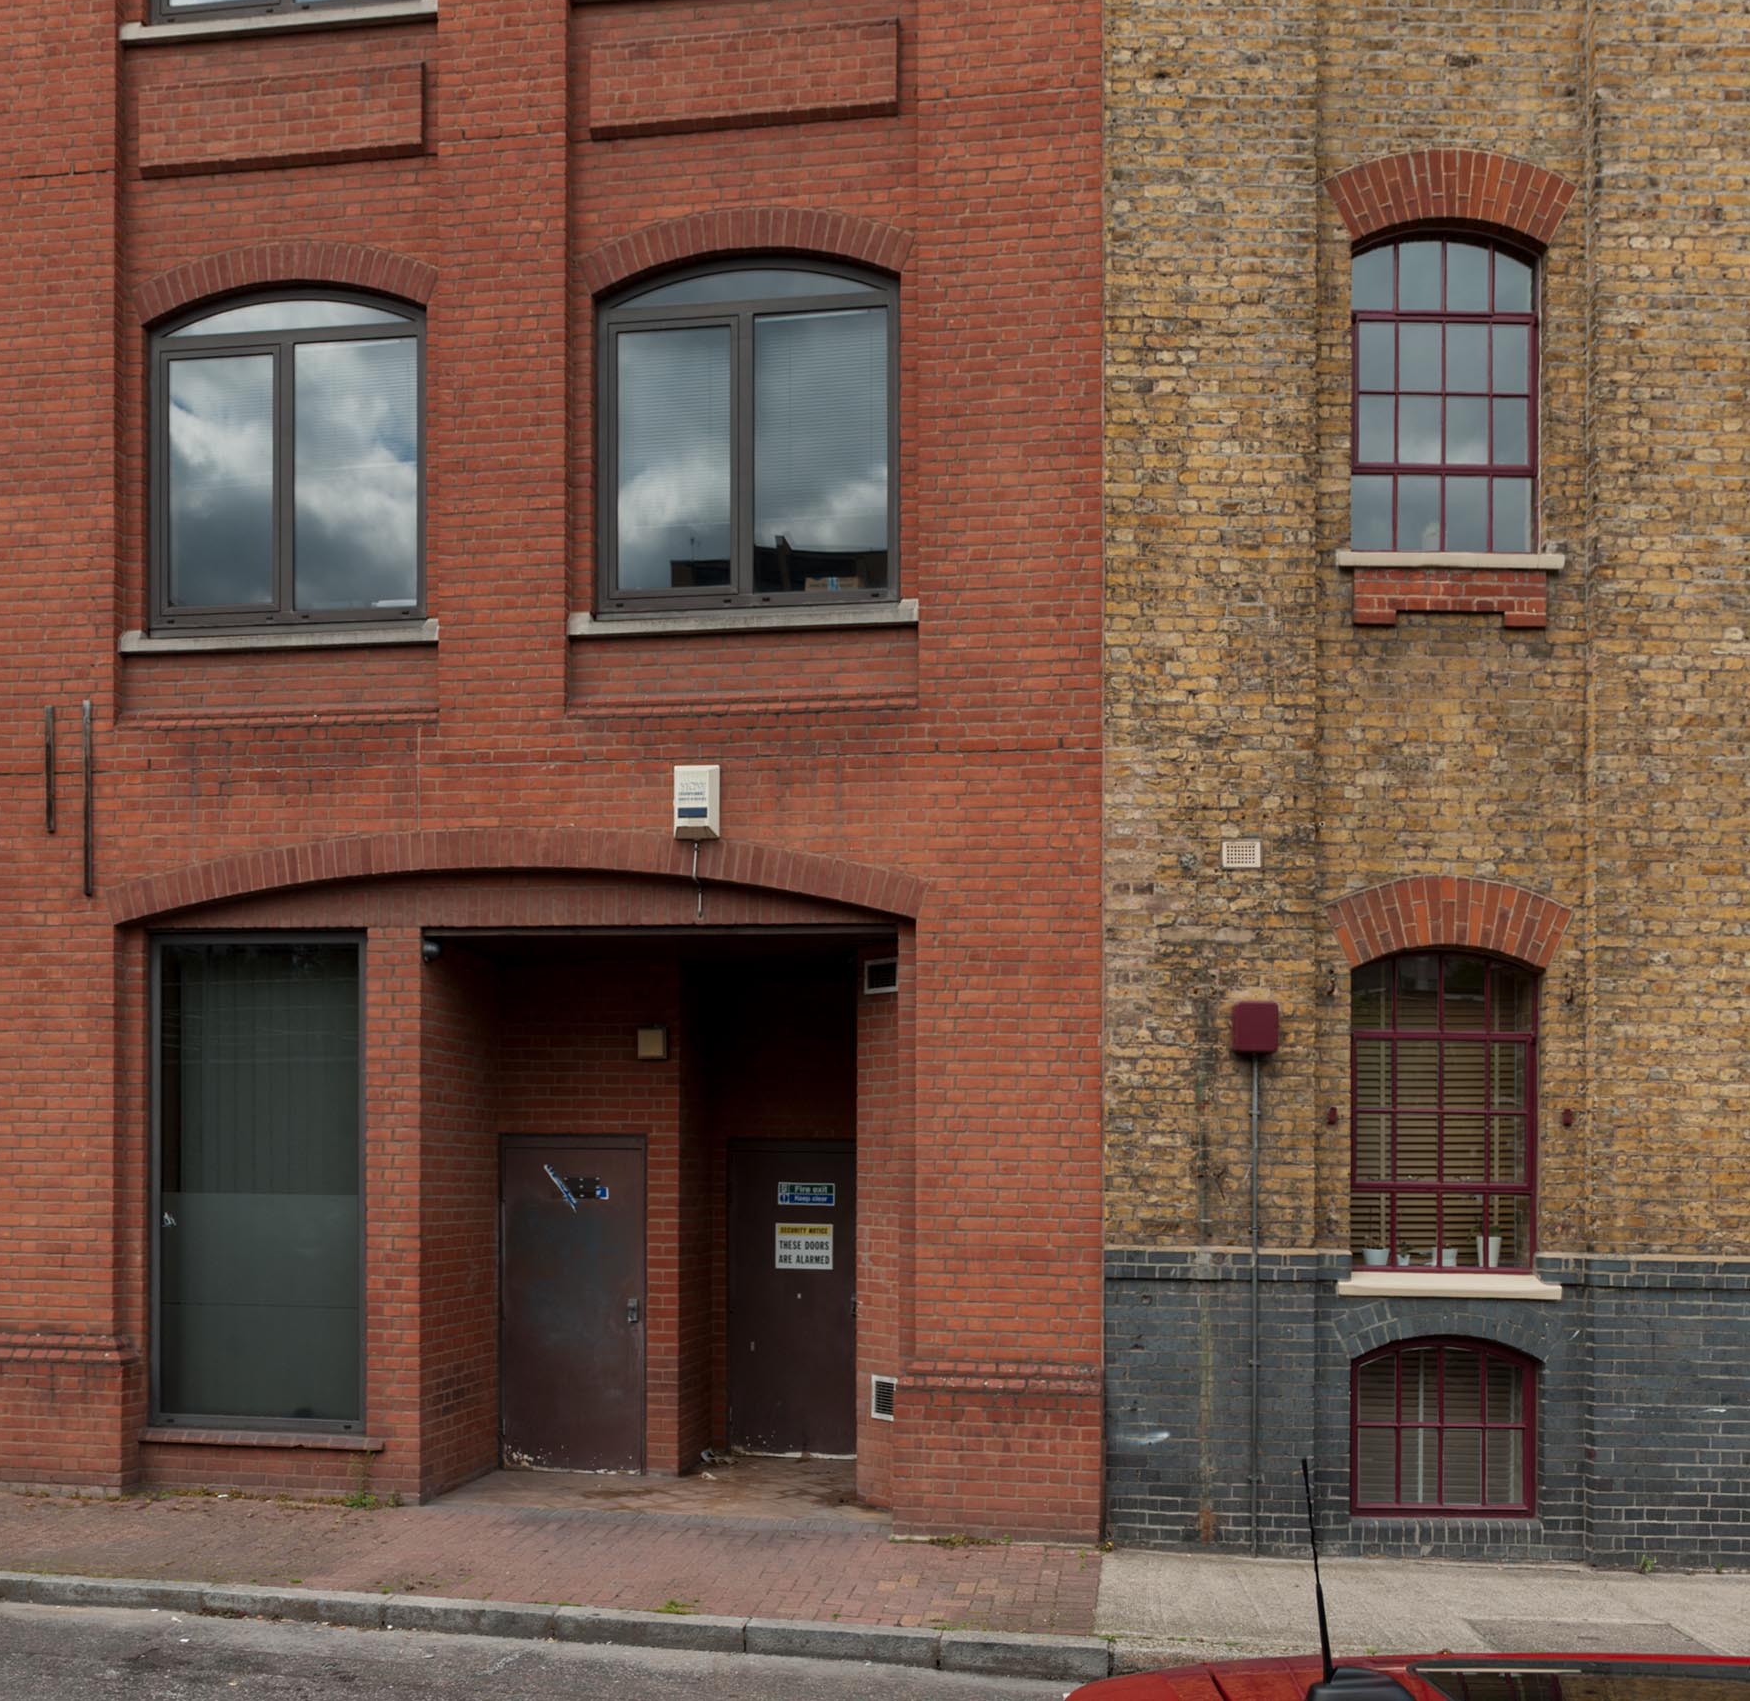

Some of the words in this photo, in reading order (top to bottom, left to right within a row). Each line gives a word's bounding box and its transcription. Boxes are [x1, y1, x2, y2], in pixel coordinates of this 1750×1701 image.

[794, 1185, 811, 1194] Fire
[812, 1185, 828, 1194] exit
[794, 1195, 811, 1203] Keep
[780, 1226, 807, 1235] SECURITY
[808, 1227, 828, 1235] NOTICE
[779, 1240, 801, 1250] THESE
[804, 1240, 830, 1251] DOORS
[778, 1254, 792, 1264] ARE
[795, 1255, 830, 1265] ALARMED
